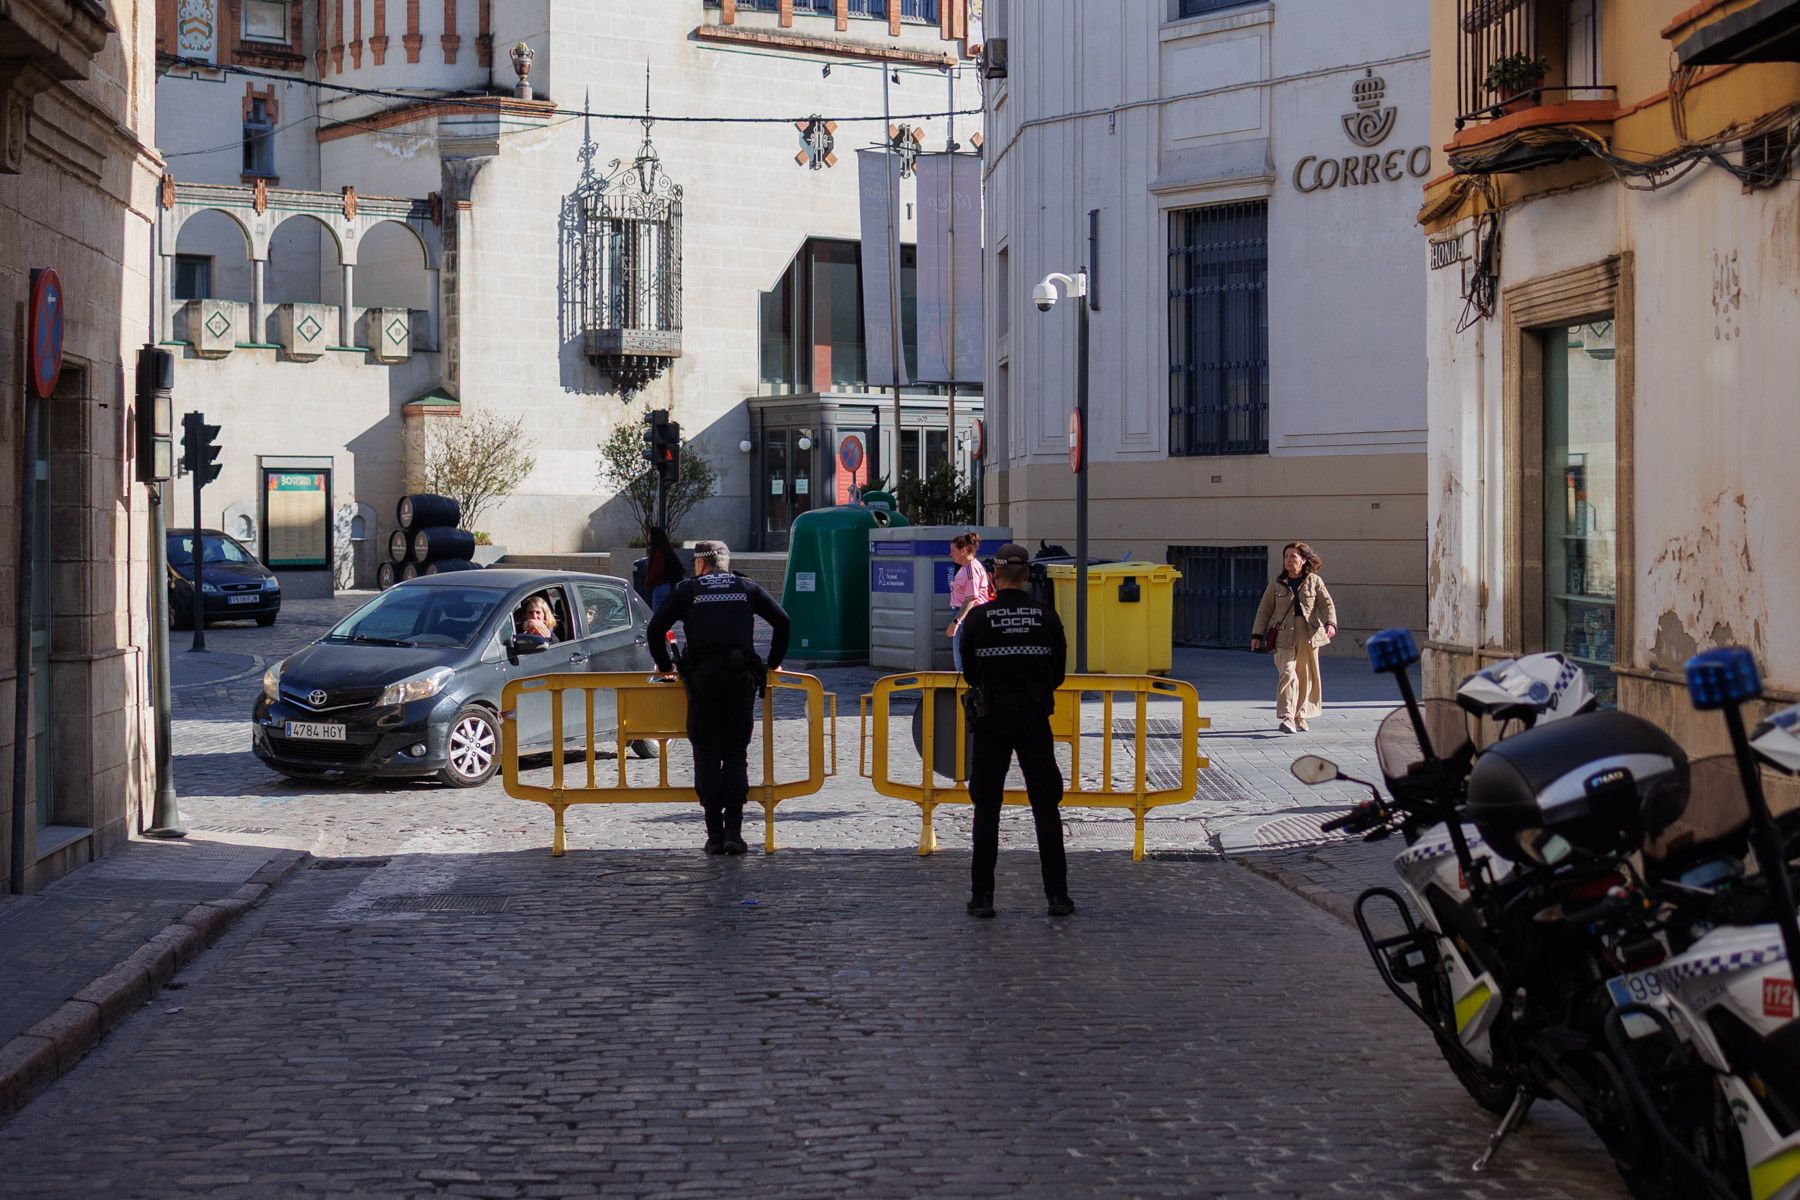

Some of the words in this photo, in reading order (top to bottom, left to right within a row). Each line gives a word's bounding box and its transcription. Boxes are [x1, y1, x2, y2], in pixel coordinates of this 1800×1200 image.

[1431, 237, 1464, 269] HONDA
[986, 607, 1042, 618] POLICIA
[991, 617, 1042, 627] LOCAL
[293, 724, 320, 736] 4784
[323, 725, 343, 738] HGY
[1763, 983, 1793, 1006] 112
